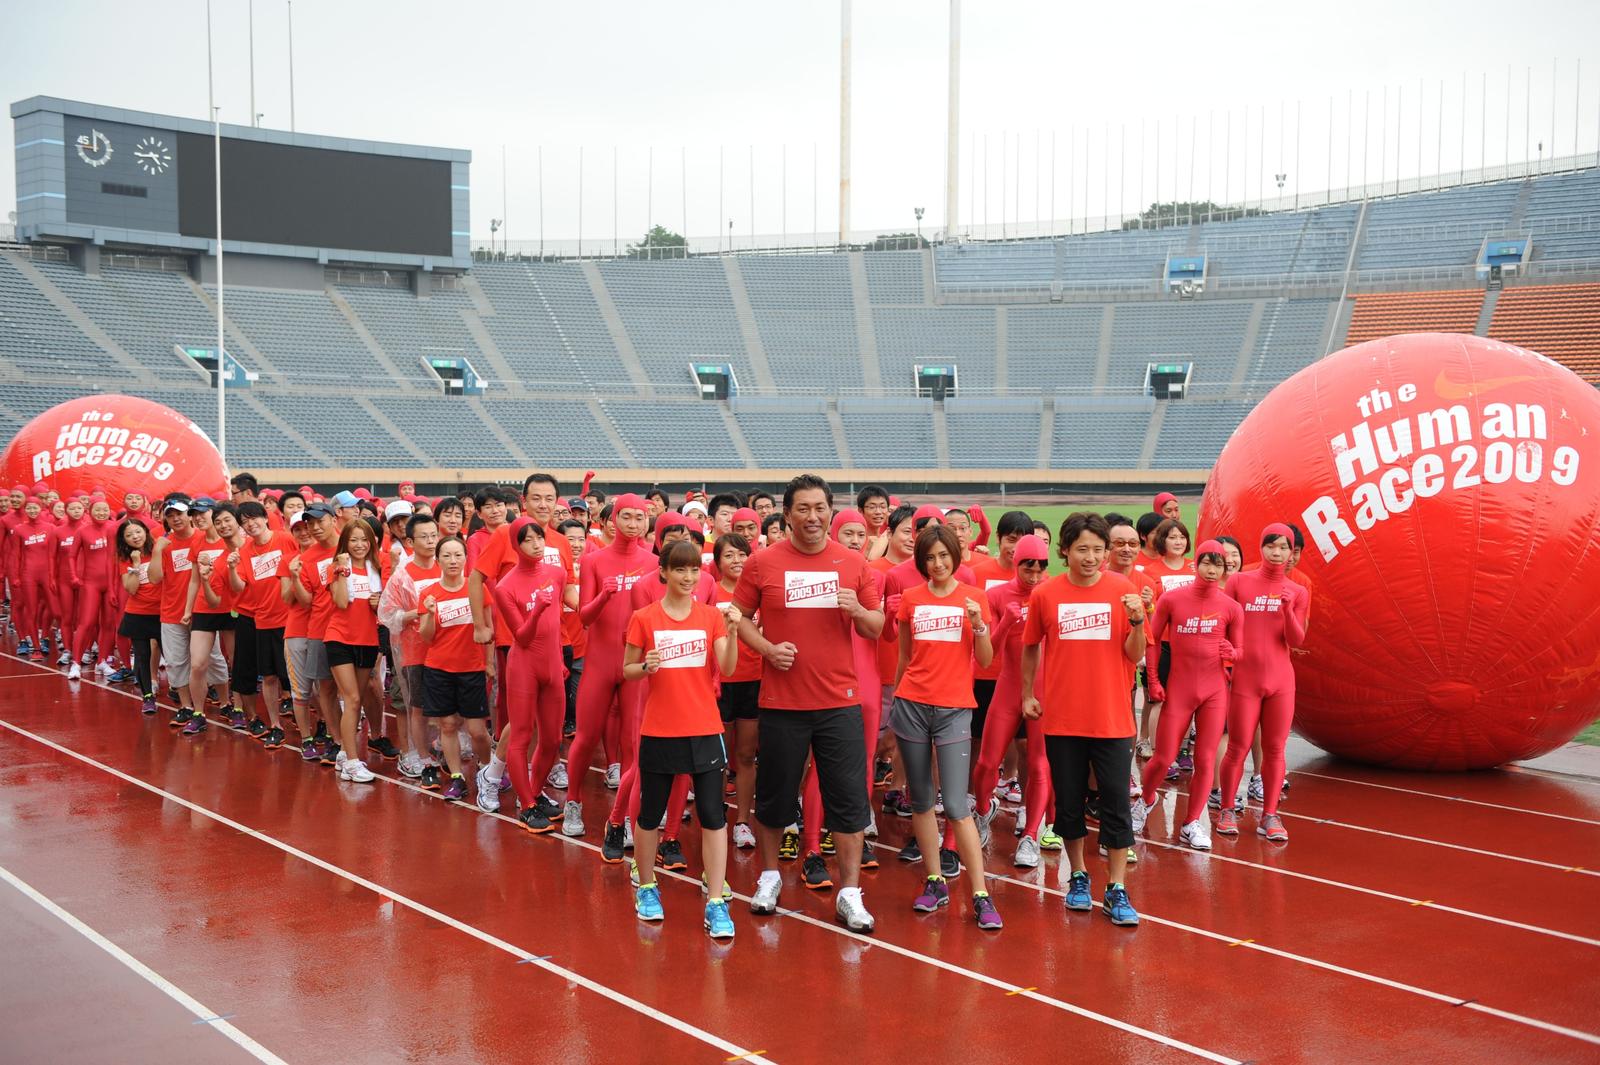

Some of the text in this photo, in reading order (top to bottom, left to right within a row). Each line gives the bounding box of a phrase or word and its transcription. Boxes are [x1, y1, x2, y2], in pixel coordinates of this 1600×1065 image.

[77, 135, 89, 145] 45
[1356, 383, 1417, 418] the
[82, 410, 114, 422] the
[56, 422, 169, 457] Human
[1330, 402, 1547, 489] Human
[32, 445, 175, 482] Race 2009
[1301, 440, 1580, 564] Race 2009
[787, 581, 837, 601] 2009.10.24
[914, 616, 961, 633] 2009.10.24
[1061, 613, 1109, 633] 2009.10.24
